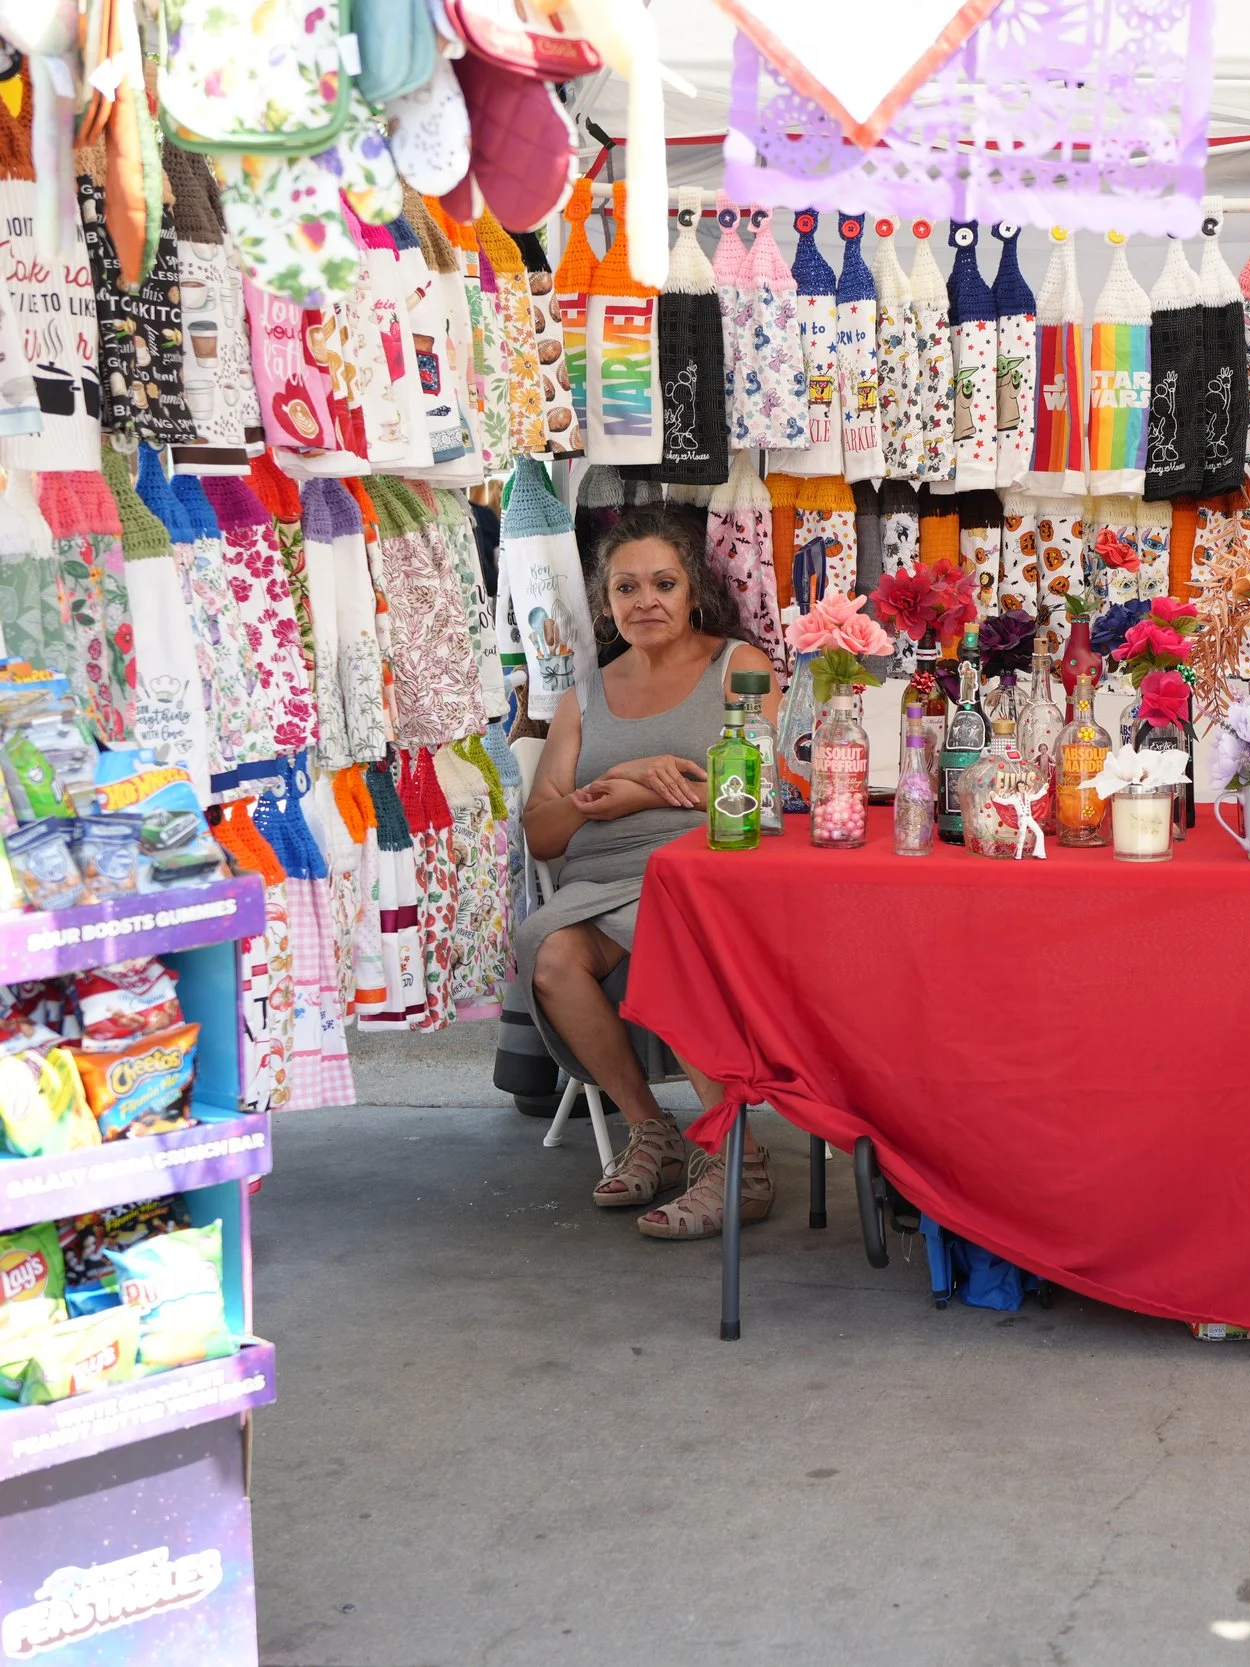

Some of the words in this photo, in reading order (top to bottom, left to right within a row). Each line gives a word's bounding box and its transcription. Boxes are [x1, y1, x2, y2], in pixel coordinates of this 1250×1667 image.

[142, 282, 164, 302] this
[135, 302, 181, 322] KITC
[811, 321, 826, 336] to
[855, 328, 866, 341] to
[602, 298, 654, 436] MARVEL
[1063, 748, 1107, 761] ABSOLU
[1064, 759, 1104, 773] MANDR
[110, 1049, 181, 1096] Cheetos
[1, 1253, 46, 1299] Lay's
